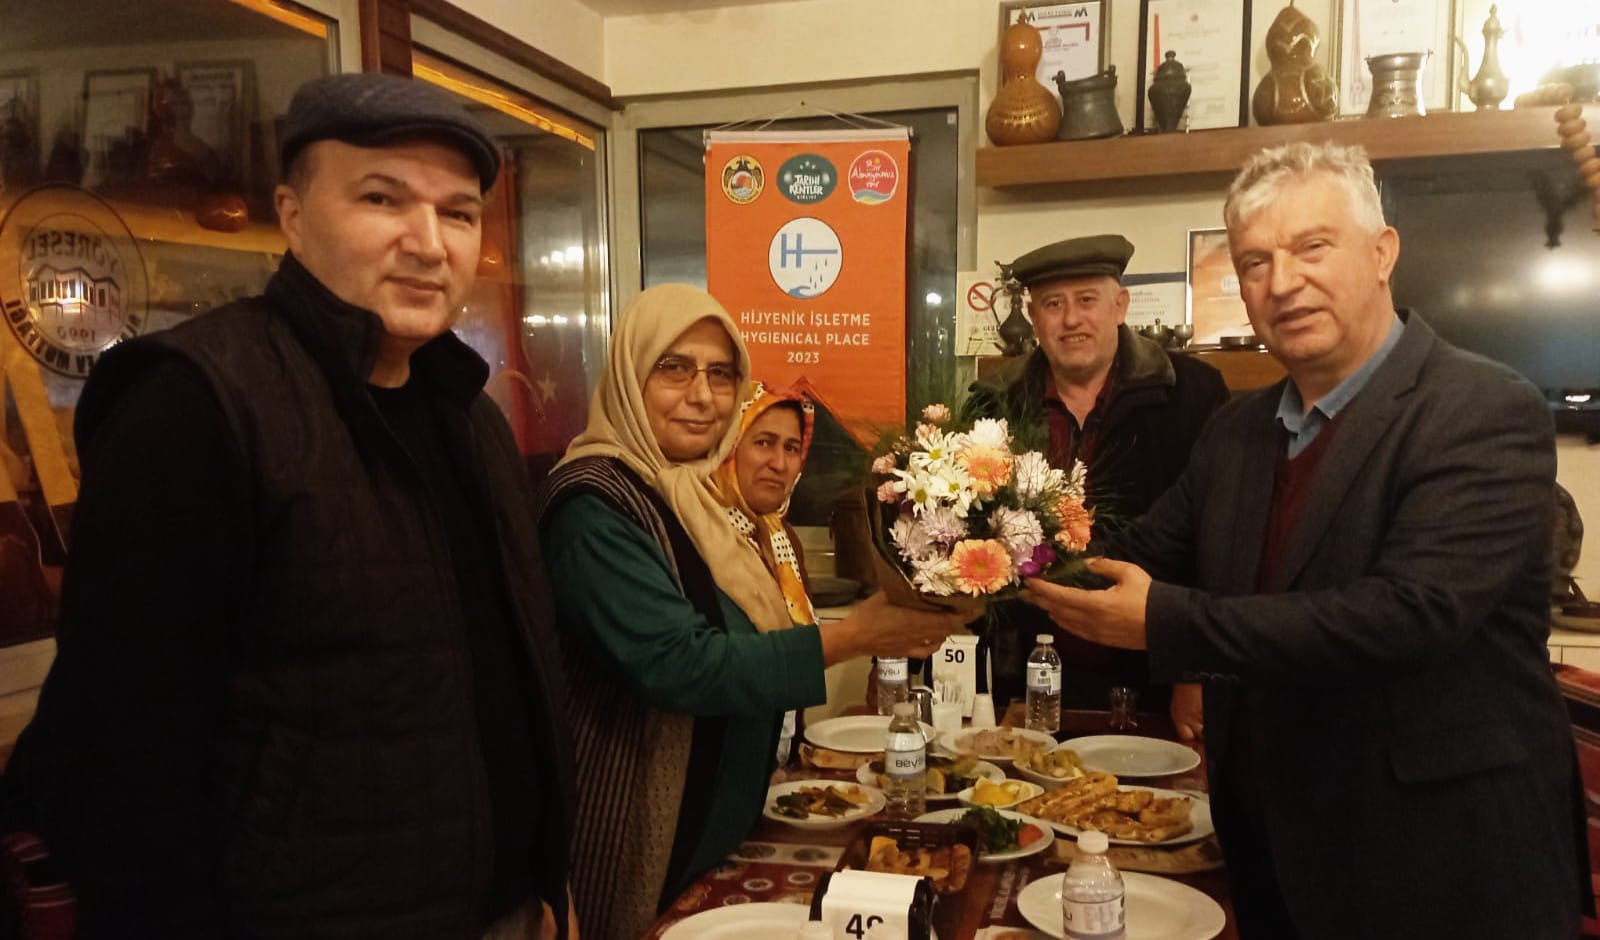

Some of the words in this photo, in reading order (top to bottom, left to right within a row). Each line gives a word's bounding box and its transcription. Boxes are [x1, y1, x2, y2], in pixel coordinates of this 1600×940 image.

[789, 182, 824, 196] KENTLER
[740, 308, 806, 326] HİJYENİK
[810, 310, 872, 328] İŞLETME
[740, 331, 821, 345] HYGIENICAL
[825, 333, 870, 345] PLACE
[787, 352, 820, 364] 2023
[944, 649, 965, 664] 50
